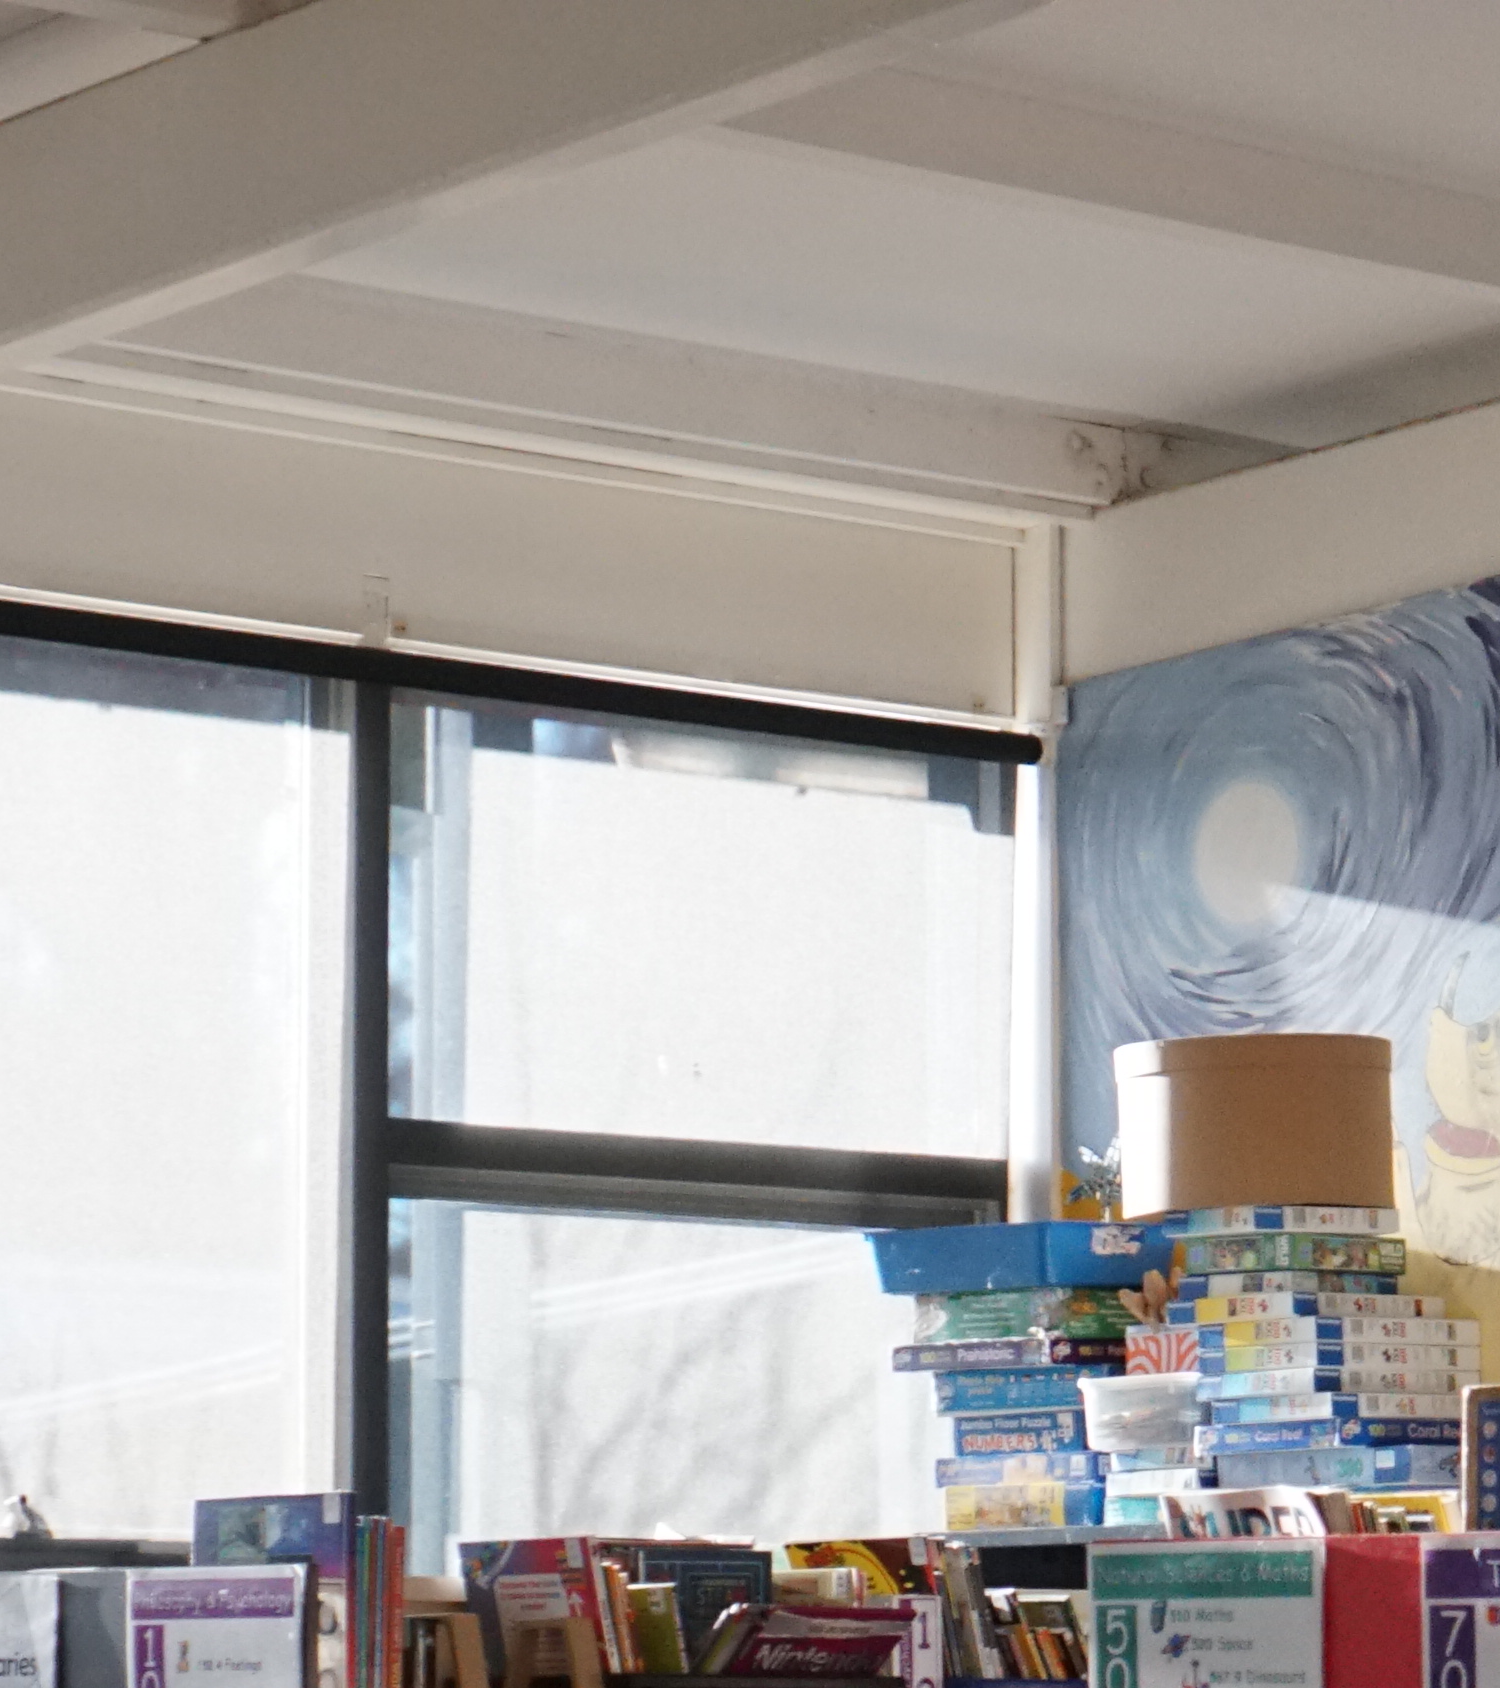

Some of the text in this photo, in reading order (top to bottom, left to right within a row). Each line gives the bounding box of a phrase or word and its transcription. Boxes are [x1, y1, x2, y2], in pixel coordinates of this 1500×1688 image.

[1407, 1423, 1440, 1439] Coral
[962, 1434, 1036, 1450] NUMBERS
[1257, 1559, 1310, 1582] Maths
[1195, 1609, 1234, 1623] Maths
[1217, 1637, 1253, 1652] Space
[1246, 1669, 1306, 1685] Dinosaurs
